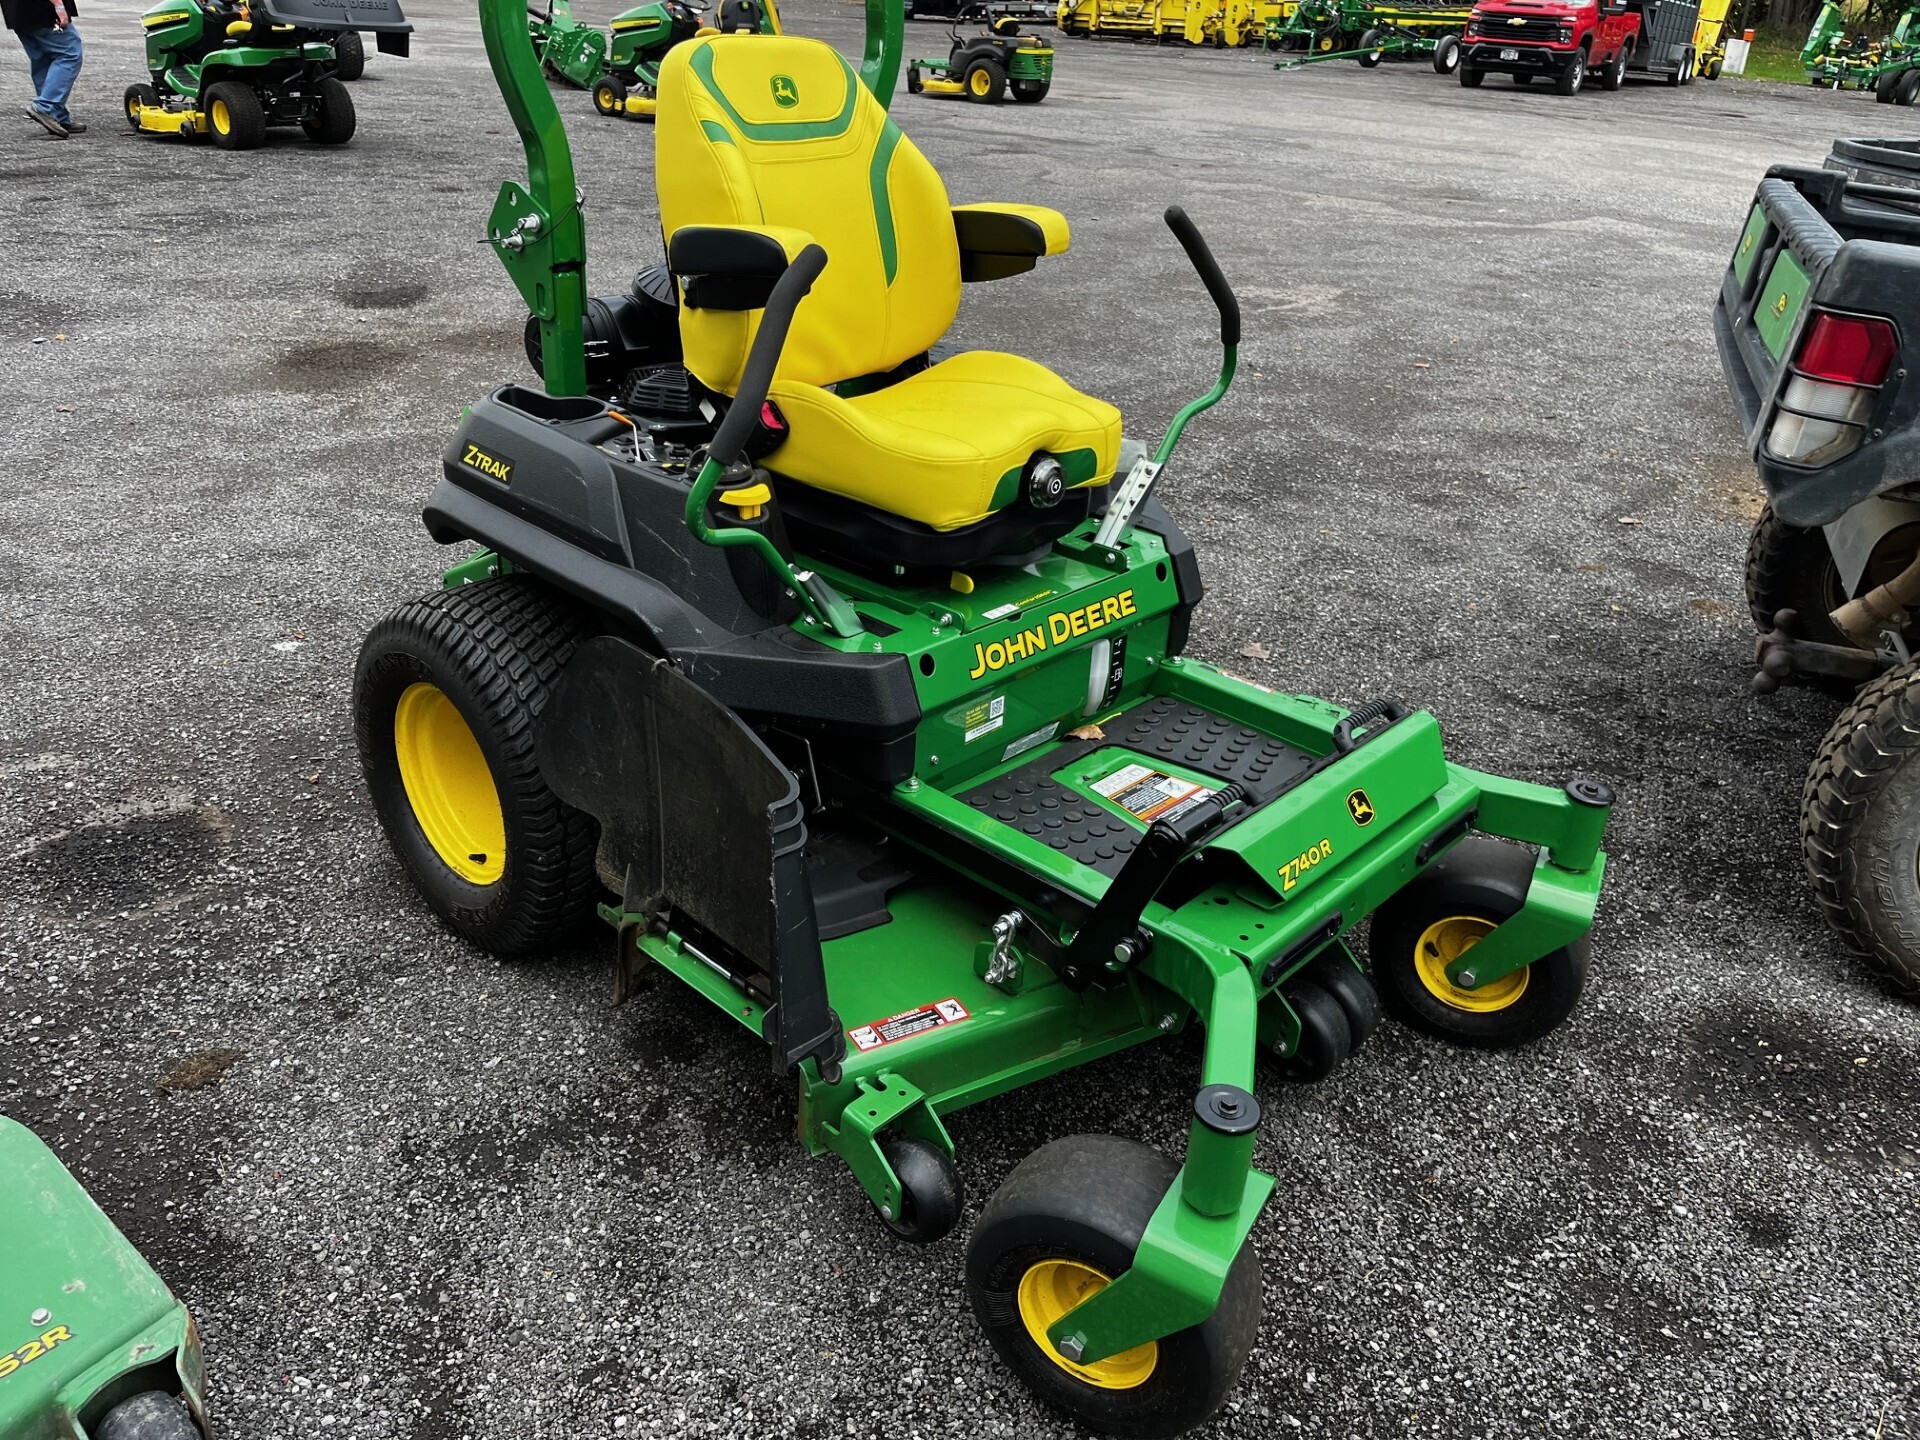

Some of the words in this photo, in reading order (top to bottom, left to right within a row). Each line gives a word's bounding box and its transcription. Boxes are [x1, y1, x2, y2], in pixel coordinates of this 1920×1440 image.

[463, 444, 511, 482] ZTRAK
[969, 624, 1047, 680] JOHN
[1047, 588, 1137, 646] DEERE
[1277, 838, 1334, 893] Z740R
[892, 1008, 921, 1021] DANGER
